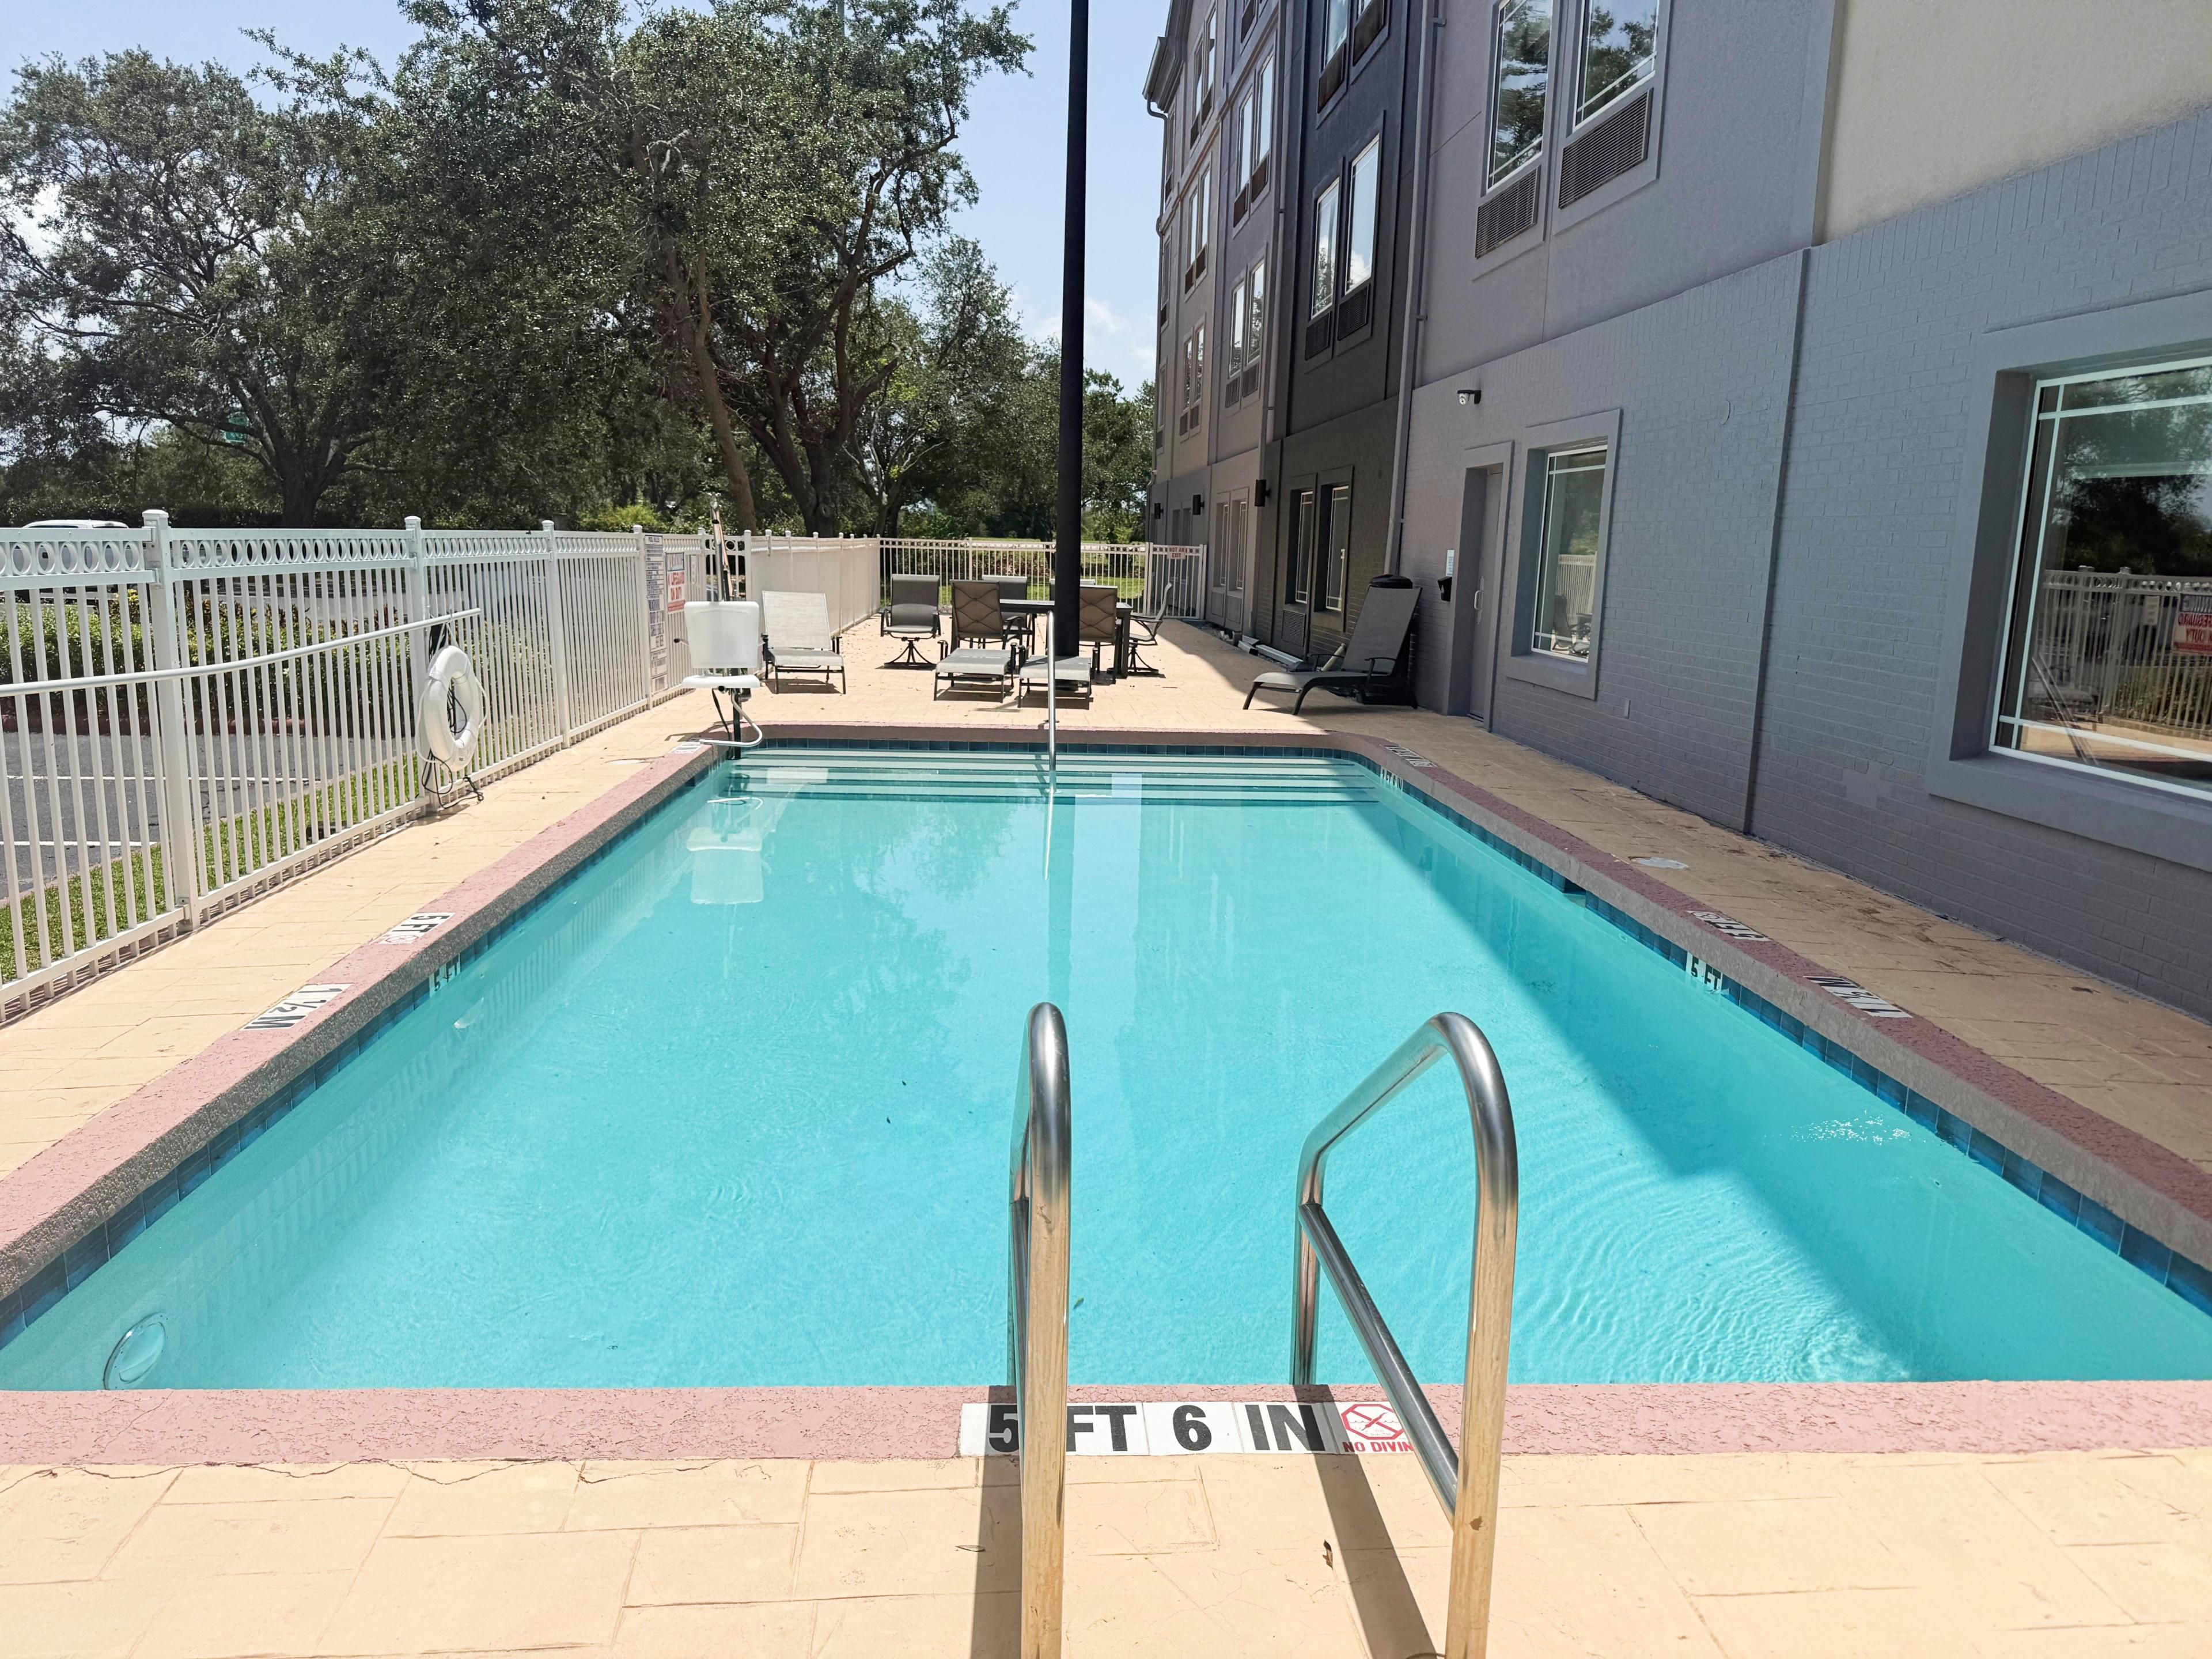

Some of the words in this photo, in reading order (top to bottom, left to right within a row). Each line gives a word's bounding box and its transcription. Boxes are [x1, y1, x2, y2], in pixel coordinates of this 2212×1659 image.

[392, 923, 439, 933] FT
[1704, 920, 1751, 931] FT
[434, 969, 441, 991] 5
[446, 955, 459, 983] FT
[1691, 956, 1699, 978] 5
[1705, 963, 1721, 990] FT
[1805, 977, 1858, 988] M
[244, 1015, 308, 1029] M
[988, 1404, 1020, 1453] 5
[1065, 1405, 1137, 1452] FT
[1172, 1404, 1212, 1452] 6
[1245, 1404, 1325, 1451] IN
[1342, 1441, 1366, 1452] NO
[1370, 1441, 1414, 1452] DIVIN
